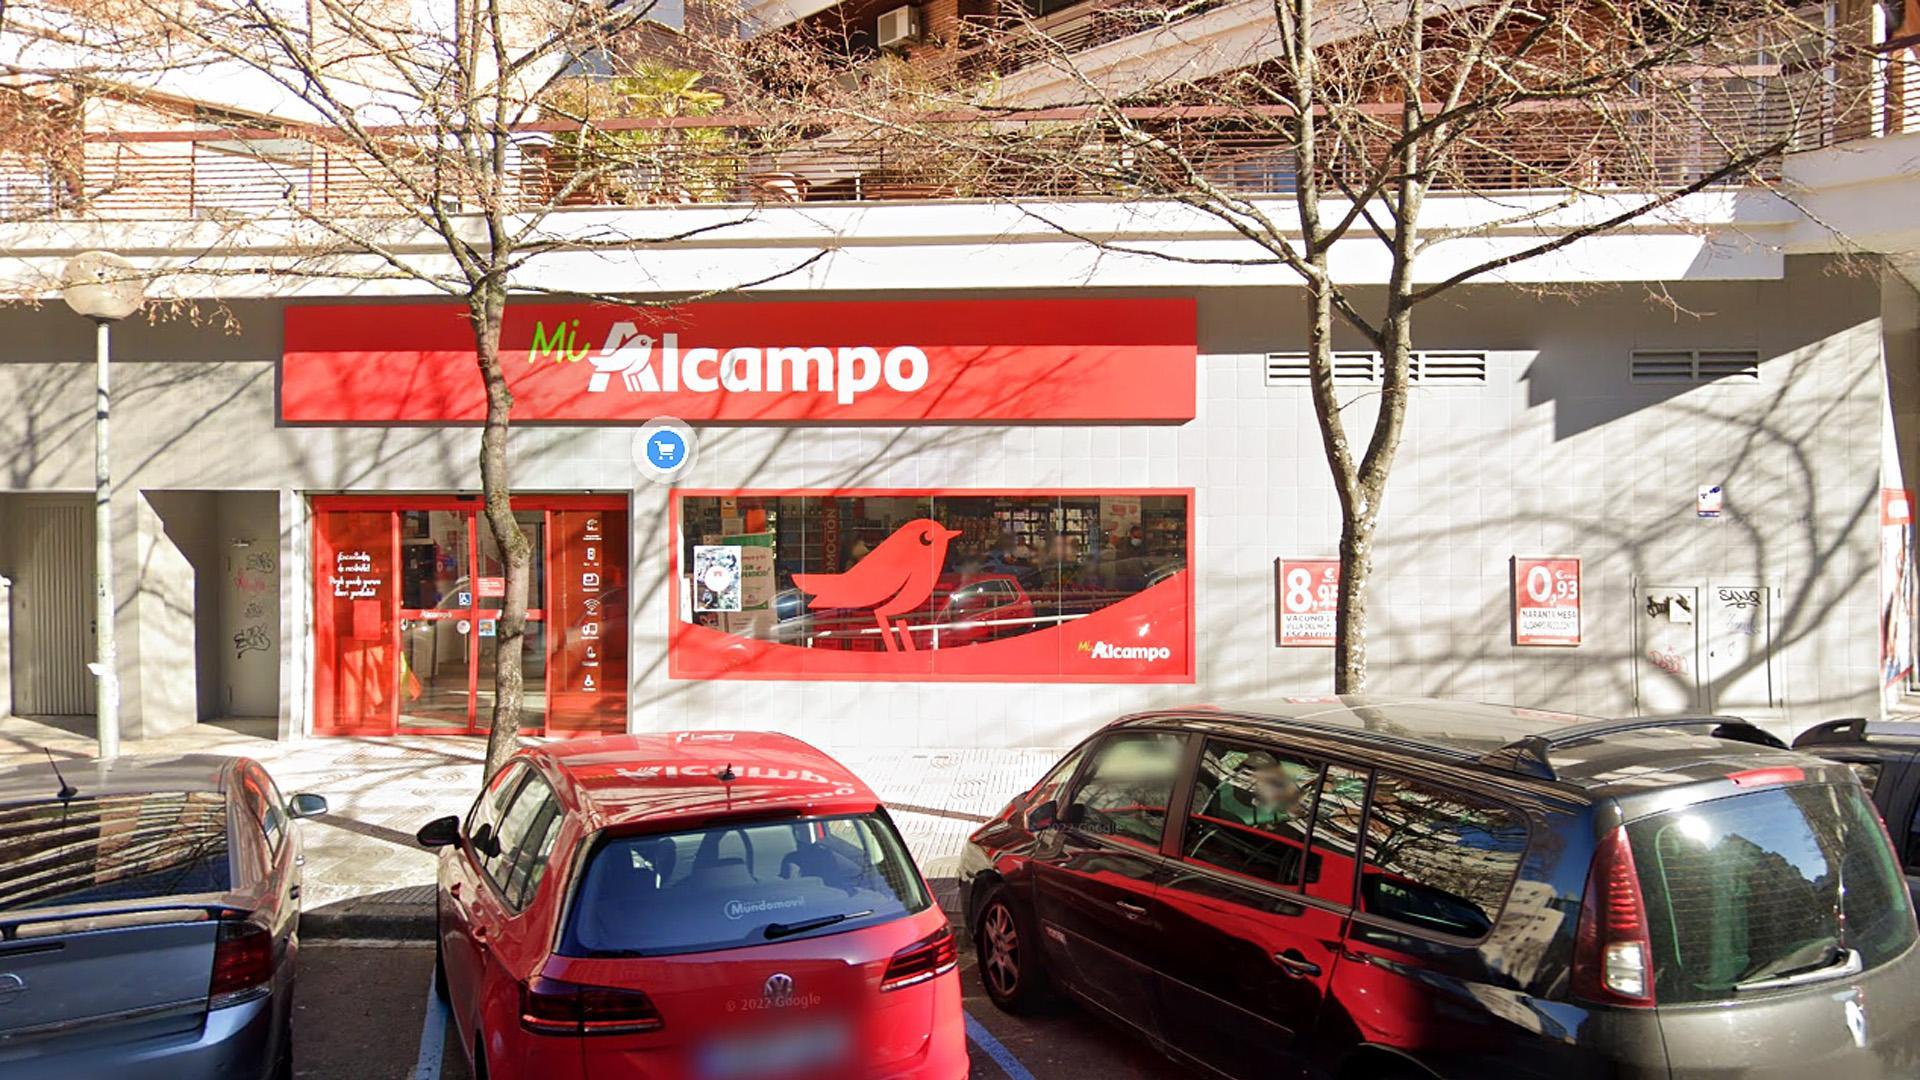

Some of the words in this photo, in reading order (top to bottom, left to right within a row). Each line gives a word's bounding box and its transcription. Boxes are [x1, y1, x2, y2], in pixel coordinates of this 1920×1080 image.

[528, 319, 590, 364] Mi
[588, 321, 930, 405] Alcampo
[824, 508, 837, 574] OMOCIÓN
[1078, 641, 1093, 652] Mi
[1091, 640, 1171, 662] Alcampo
